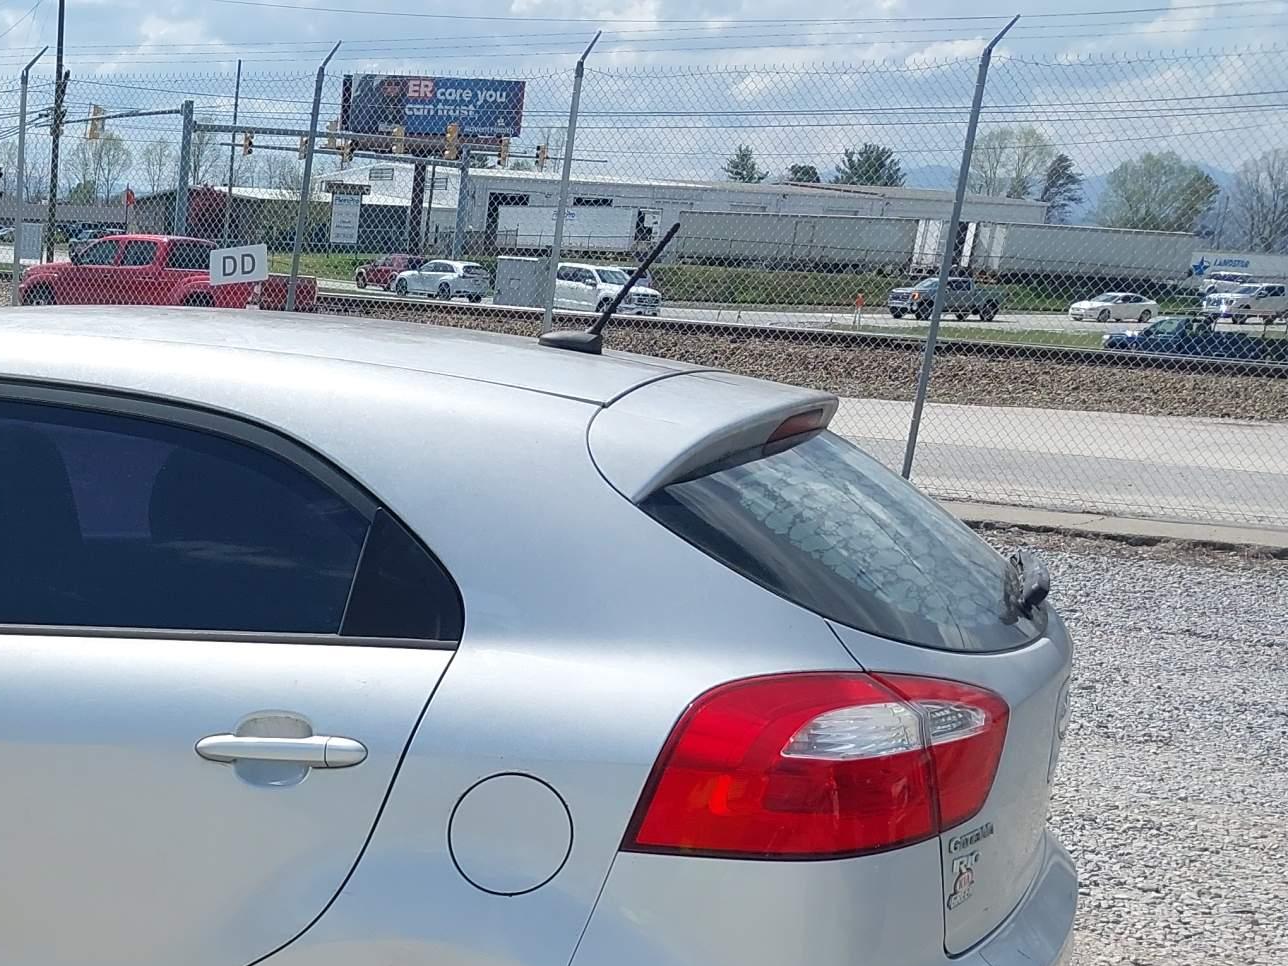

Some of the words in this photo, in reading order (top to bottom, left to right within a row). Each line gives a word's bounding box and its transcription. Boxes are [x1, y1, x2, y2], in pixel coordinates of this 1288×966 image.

[407, 80, 434, 97] ER
[437, 87, 472, 100] care
[477, 87, 506, 102] you
[405, 104, 434, 116] can
[222, 253, 256, 276] DD
